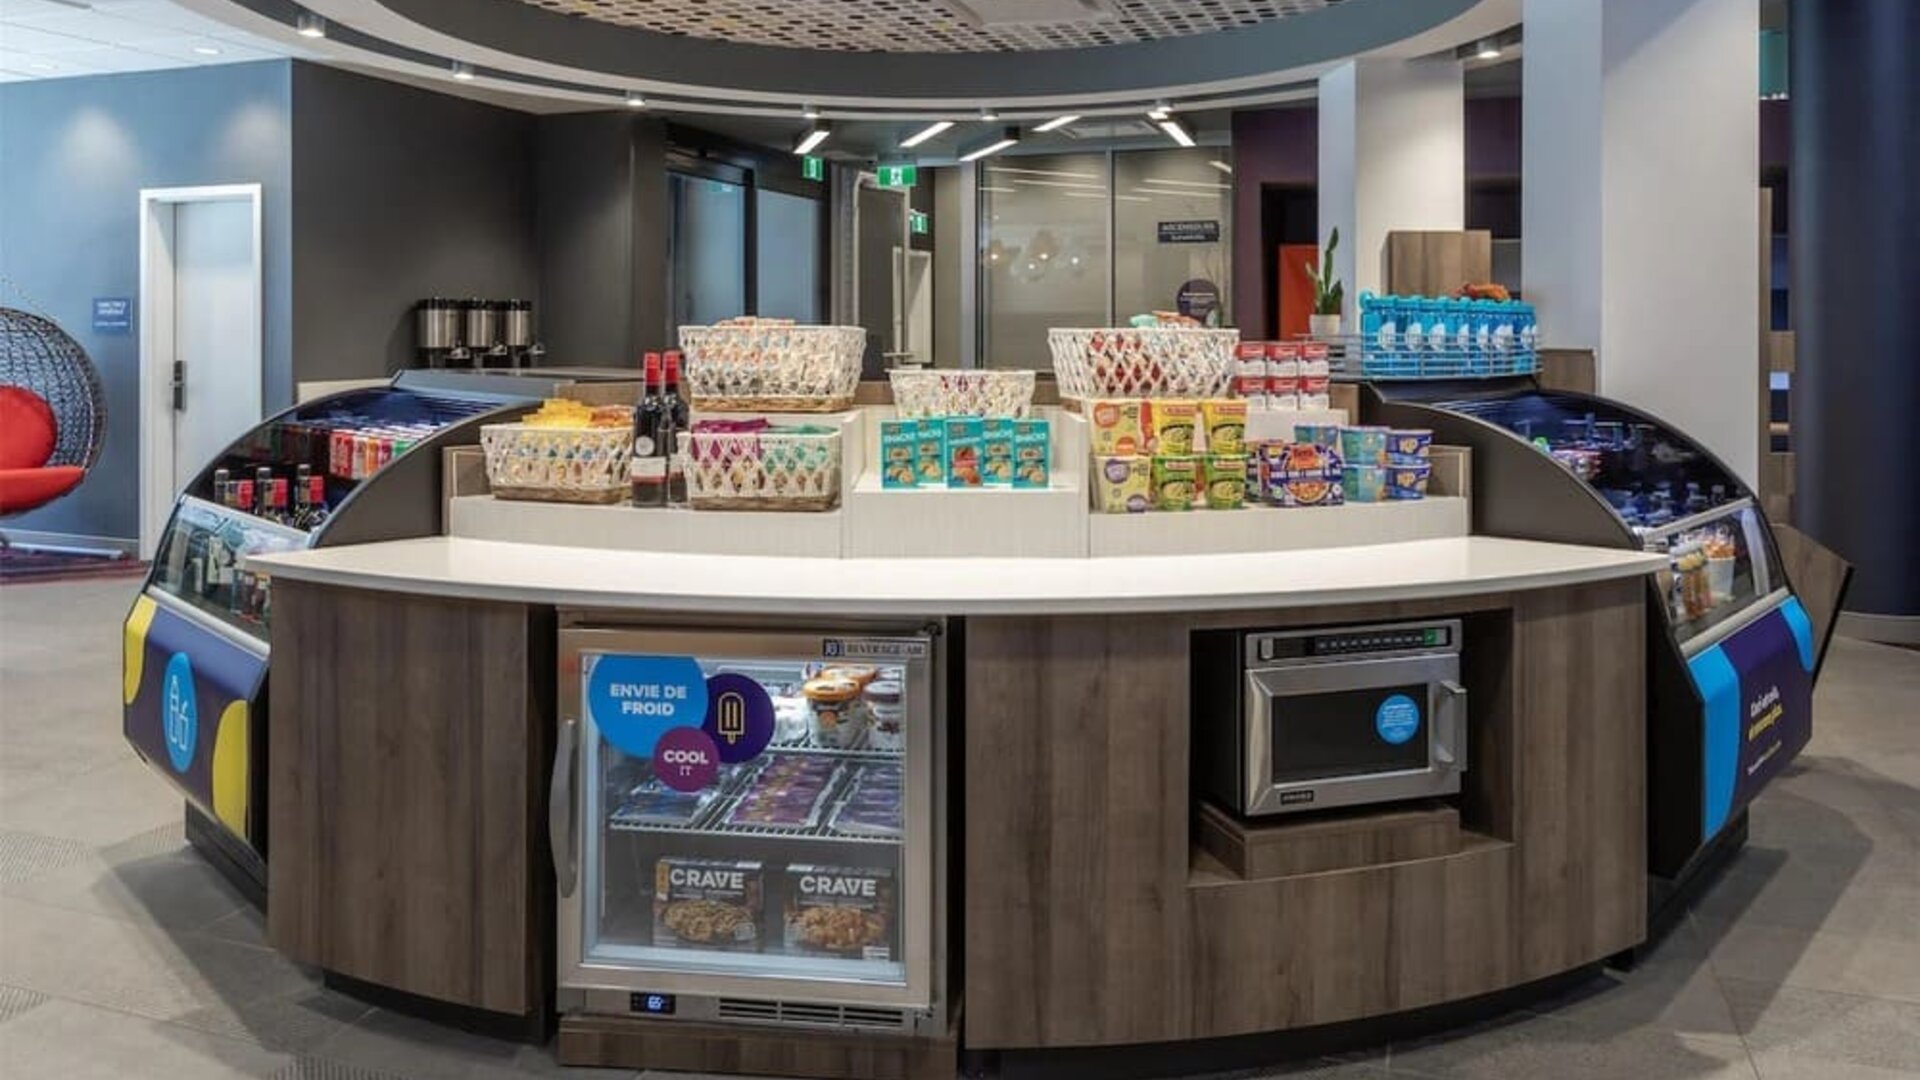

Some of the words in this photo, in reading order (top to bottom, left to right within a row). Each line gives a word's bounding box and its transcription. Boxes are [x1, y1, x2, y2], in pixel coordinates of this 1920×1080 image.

[609, 683, 661, 699] ENVIE
[664, 684, 688, 700] DE
[621, 701, 675, 716] FROID
[663, 750, 709, 764] COOL
[679, 765, 693, 776] IT
[669, 868, 744, 890] CRAVE
[799, 875, 877, 897] CRAVE
